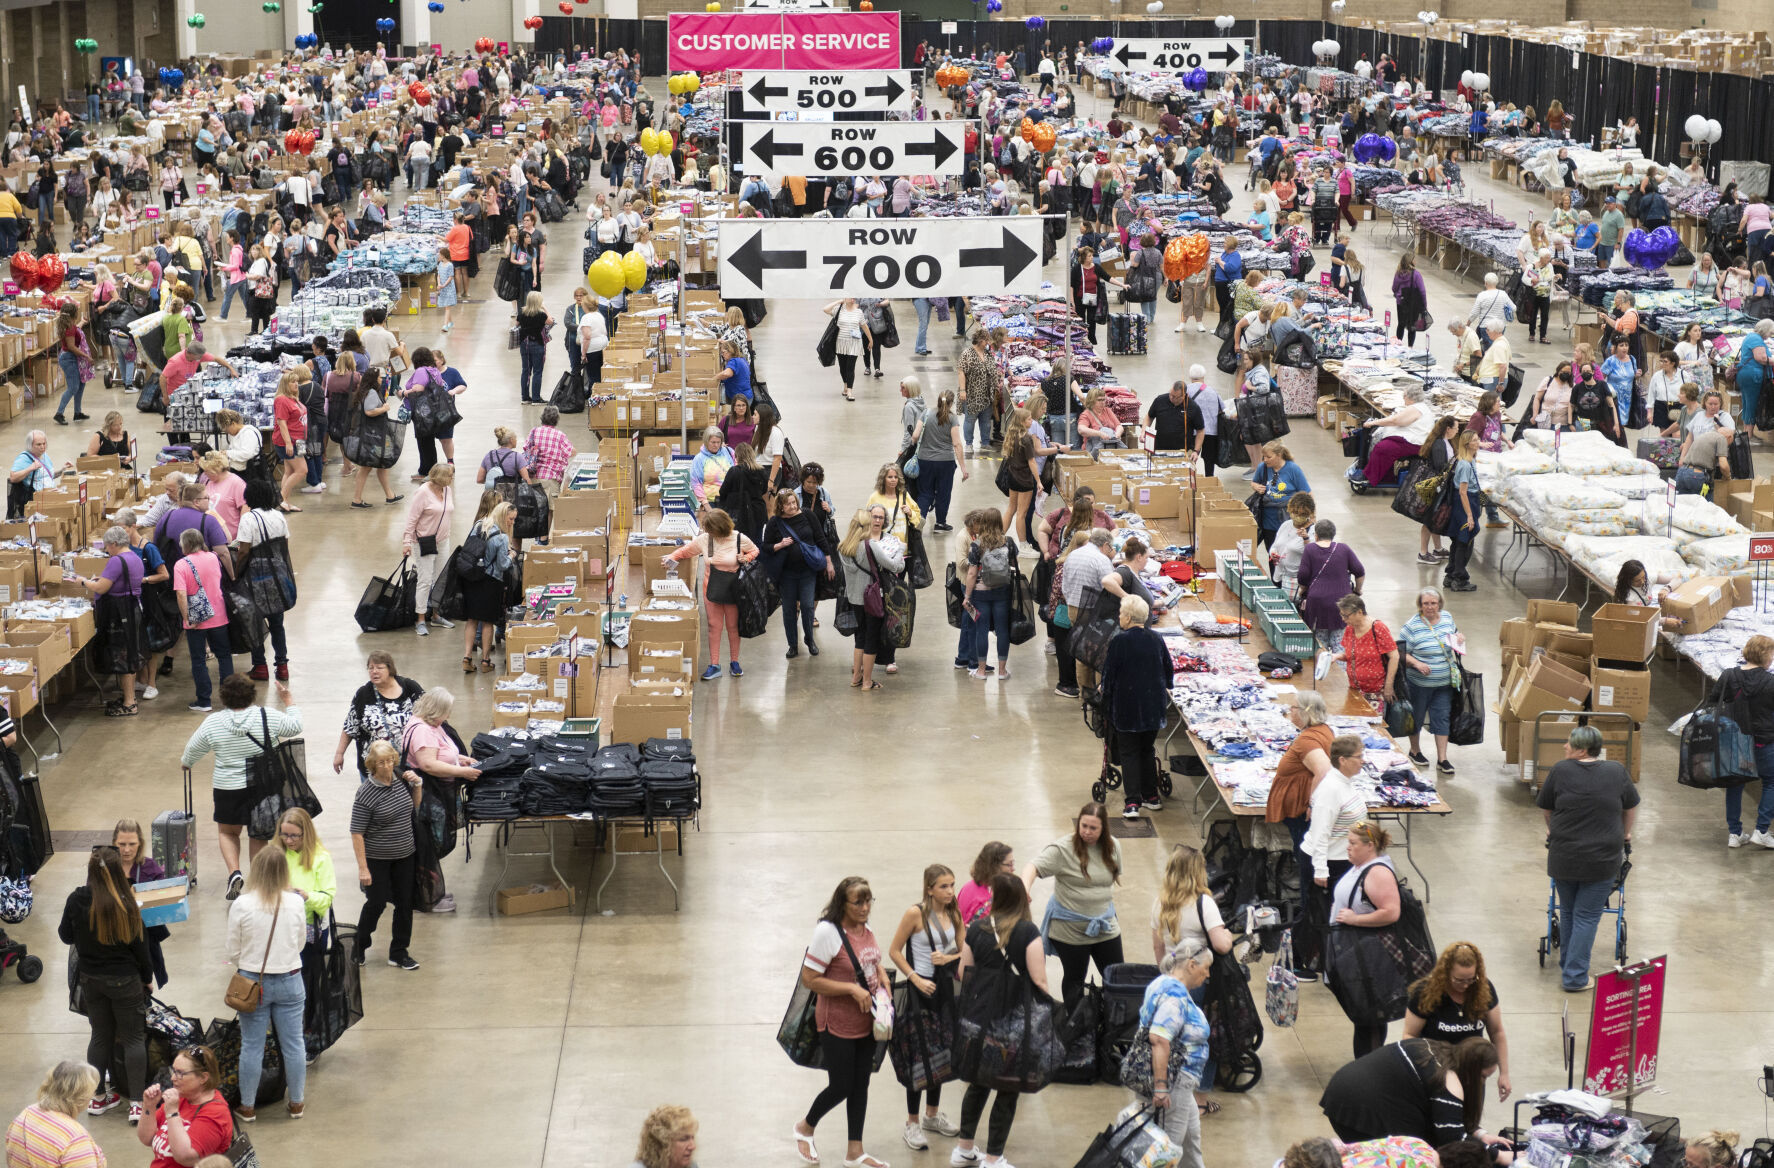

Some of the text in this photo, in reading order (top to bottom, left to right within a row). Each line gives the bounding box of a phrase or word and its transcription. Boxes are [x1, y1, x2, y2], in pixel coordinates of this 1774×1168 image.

[677, 32, 891, 51] CUSTOMER SERVICE
[1163, 42, 1191, 51] ROW
[1153, 53, 1203, 69] 400
[809, 75, 844, 86] ROW
[796, 89, 857, 109] 500
[831, 128, 877, 141] ROW
[814, 146, 894, 171] 600
[848, 228, 918, 246] ROW
[822, 254, 942, 290] 700
[1606, 989, 1634, 1004] SORTING
[1638, 984, 1652, 993] REA
[1438, 1021, 1475, 1033] Reebok
